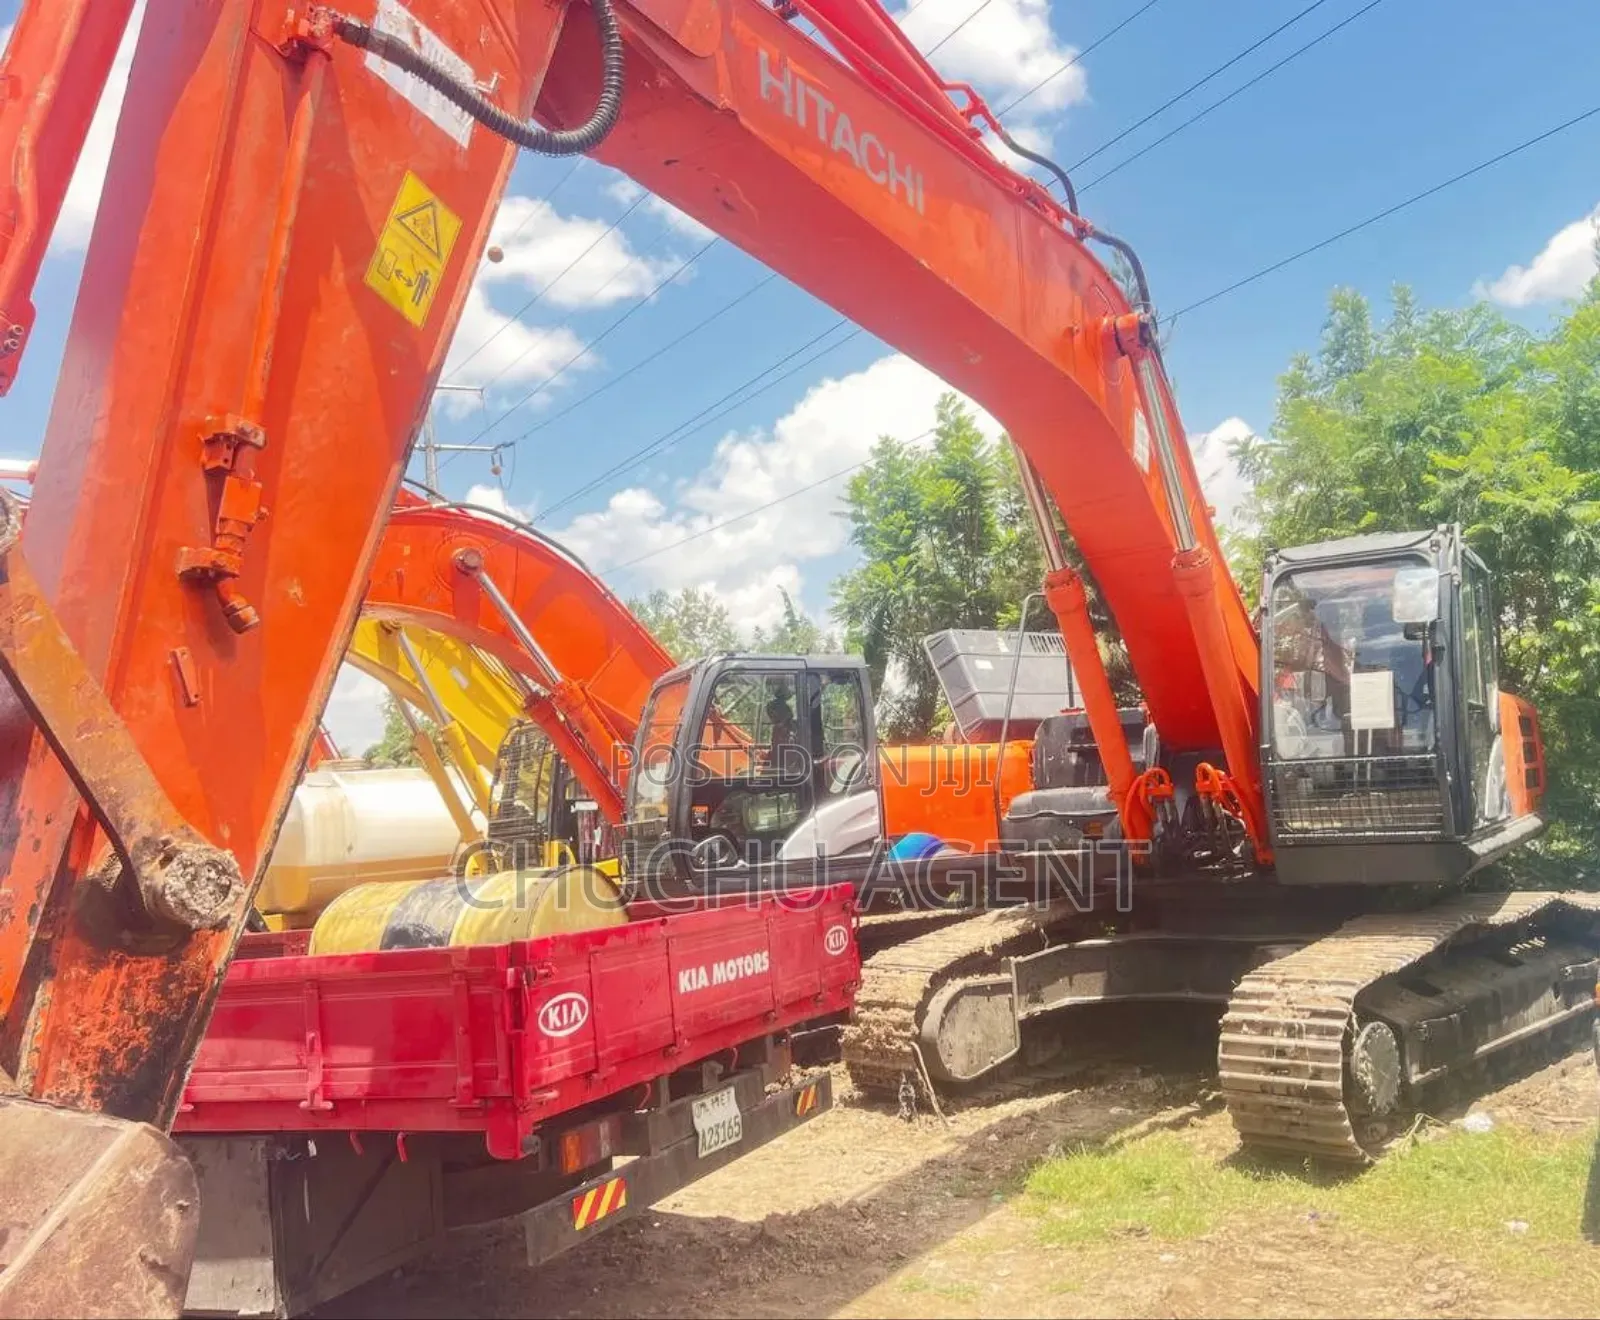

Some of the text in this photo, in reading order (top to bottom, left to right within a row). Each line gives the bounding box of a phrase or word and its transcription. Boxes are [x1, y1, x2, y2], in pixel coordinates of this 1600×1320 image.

[758, 47, 926, 215] HITACHI
[678, 950, 770, 994] KIA MOTORS
